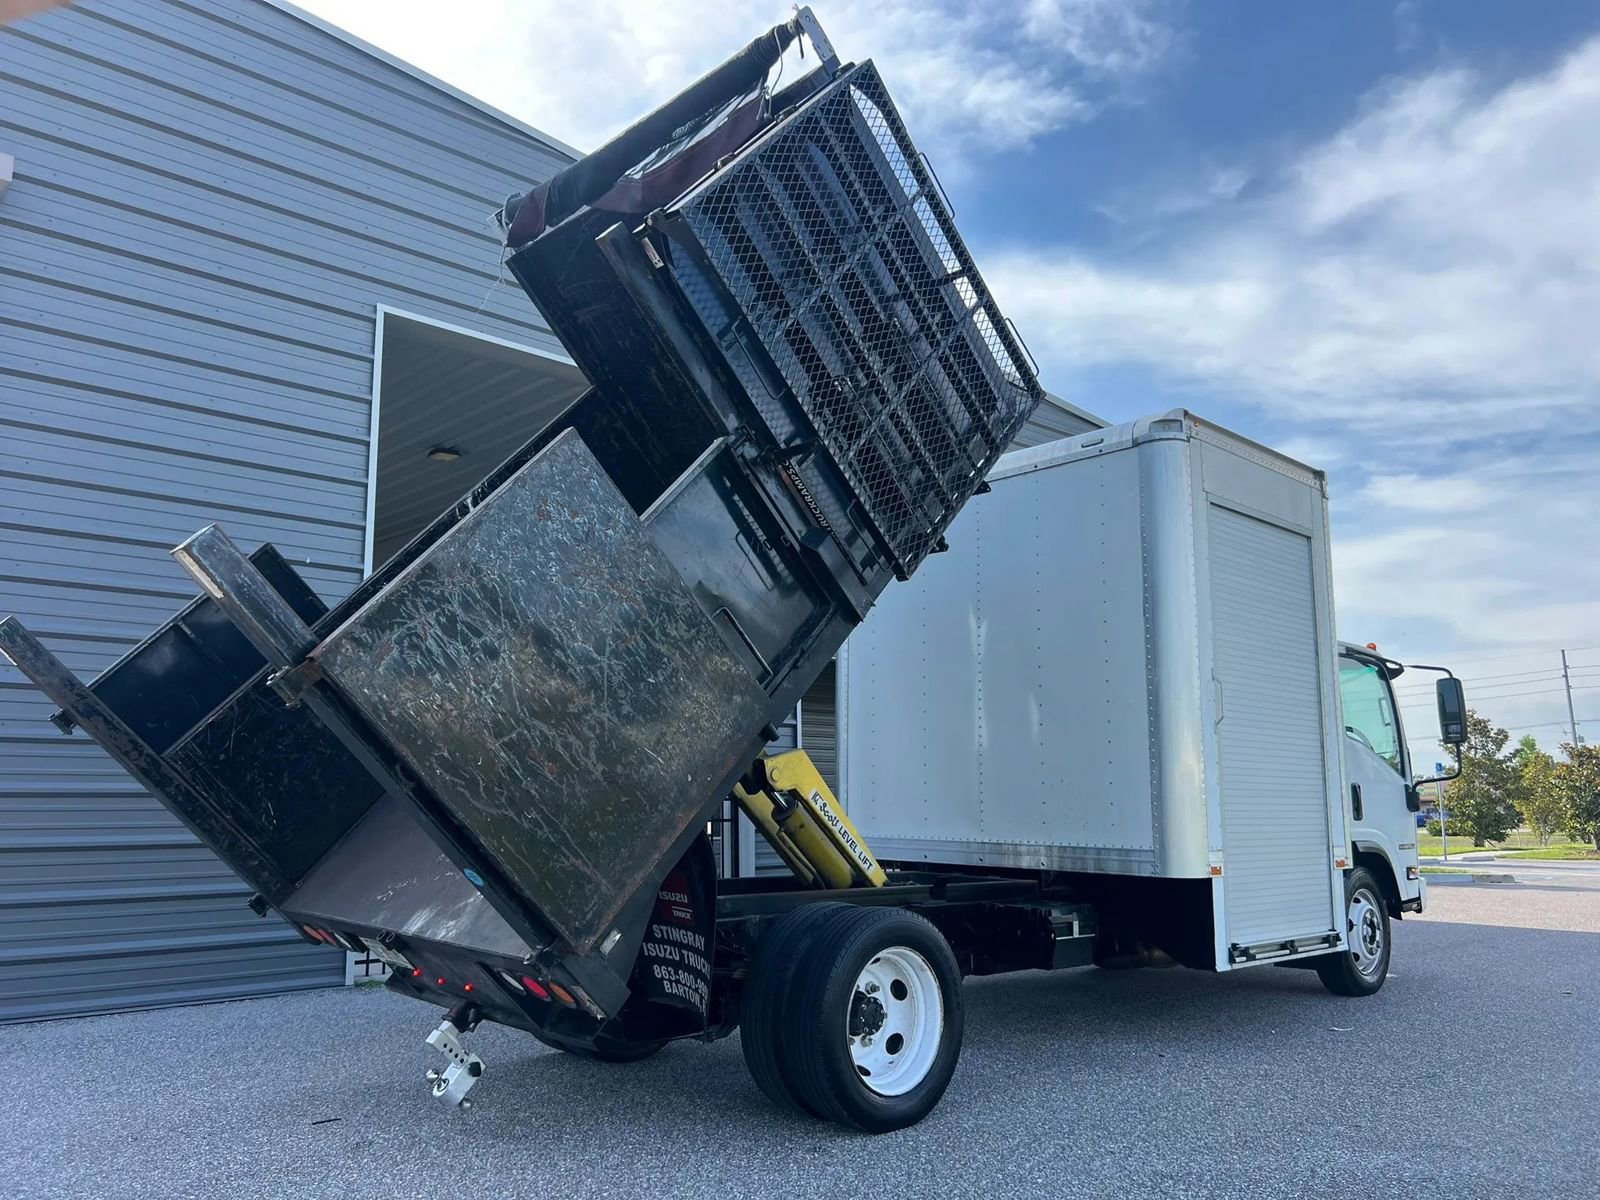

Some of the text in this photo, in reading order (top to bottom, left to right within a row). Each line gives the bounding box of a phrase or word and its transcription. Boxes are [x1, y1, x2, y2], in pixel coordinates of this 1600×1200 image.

[838, 825, 858, 854] LEVEL
[857, 851, 873, 870] LIFT
[658, 890, 688, 903] ISUZU
[671, 909, 692, 920] TRUCK
[652, 924, 705, 952] STINGRAY
[642, 942, 680, 961] ISUZU
